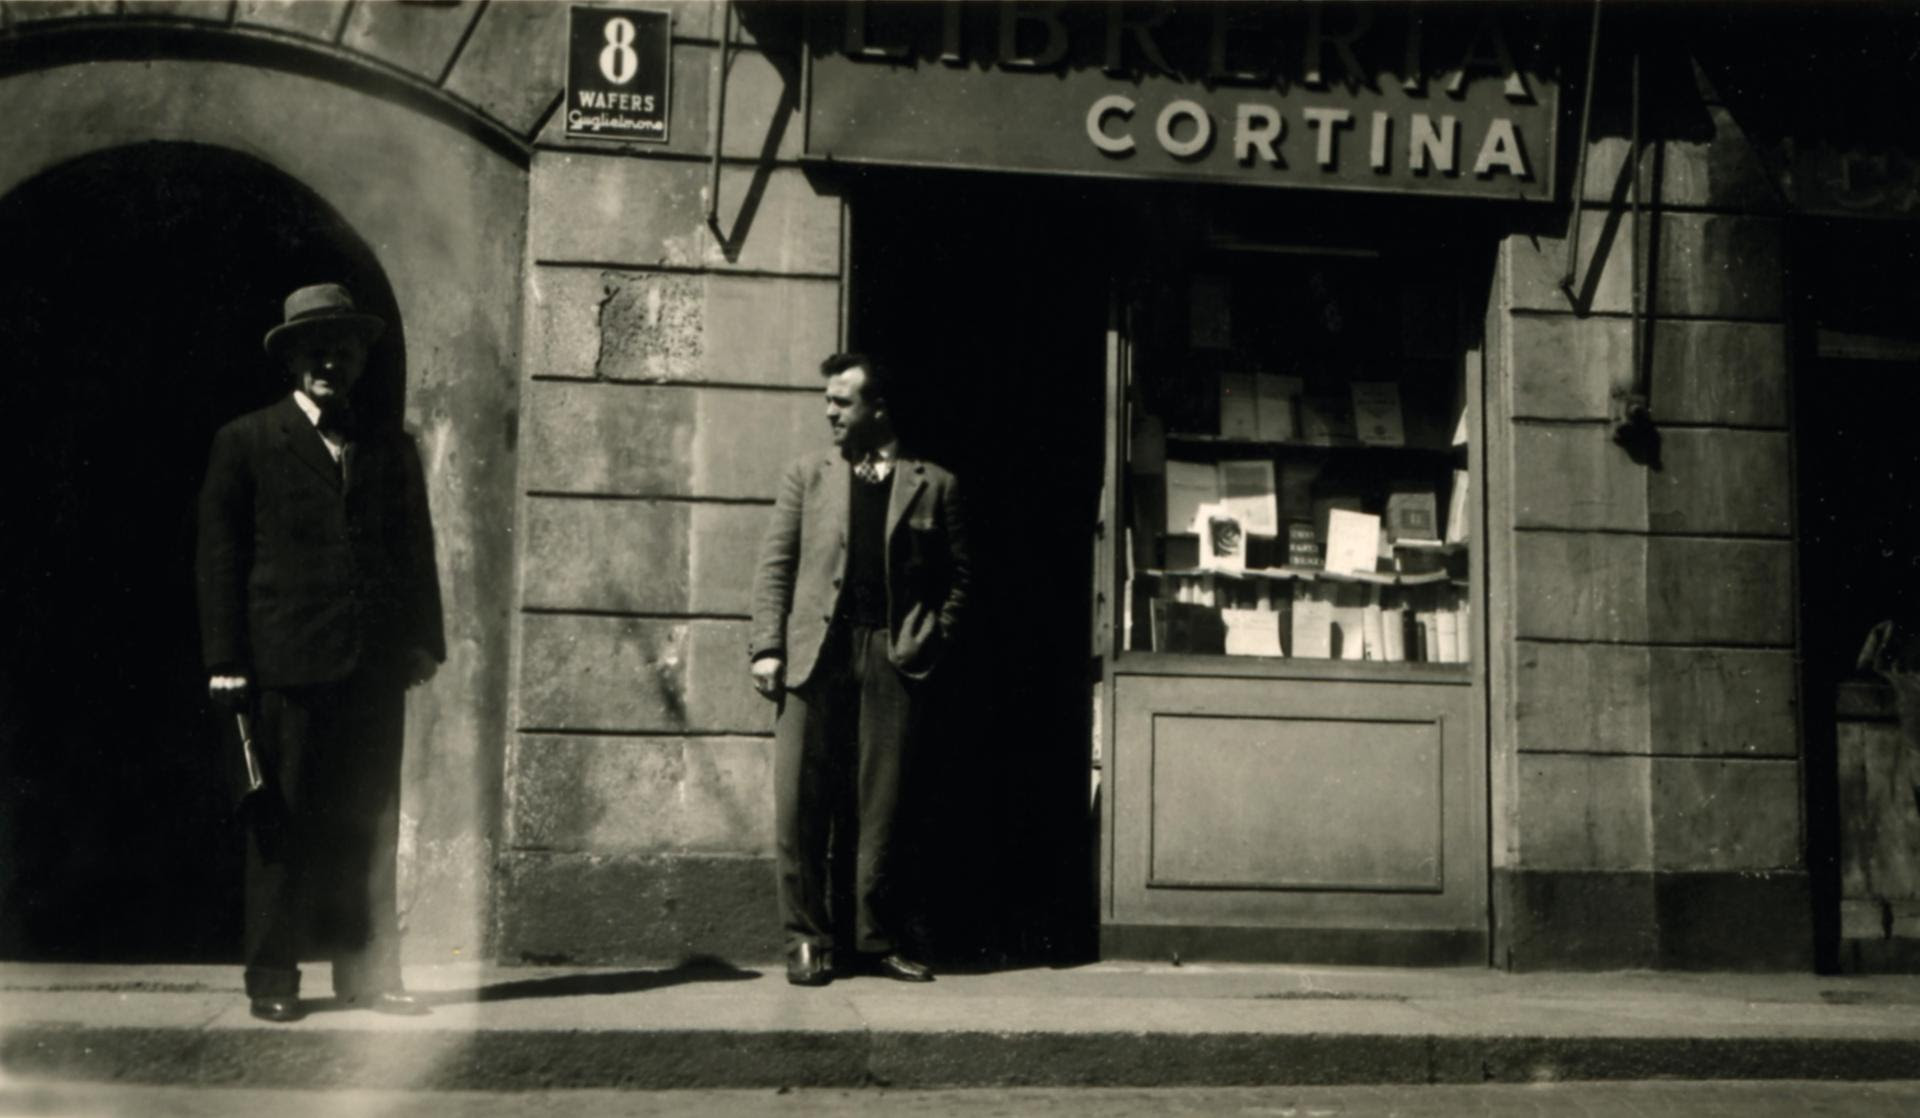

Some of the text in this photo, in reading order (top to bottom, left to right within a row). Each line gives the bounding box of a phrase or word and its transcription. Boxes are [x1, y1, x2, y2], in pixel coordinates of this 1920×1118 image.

[599, 16, 638, 85] 8
[842, 0, 1529, 97] LIBRERIA
[578, 89, 655, 113] WAFERS
[1086, 95, 1527, 176] CORTINA
